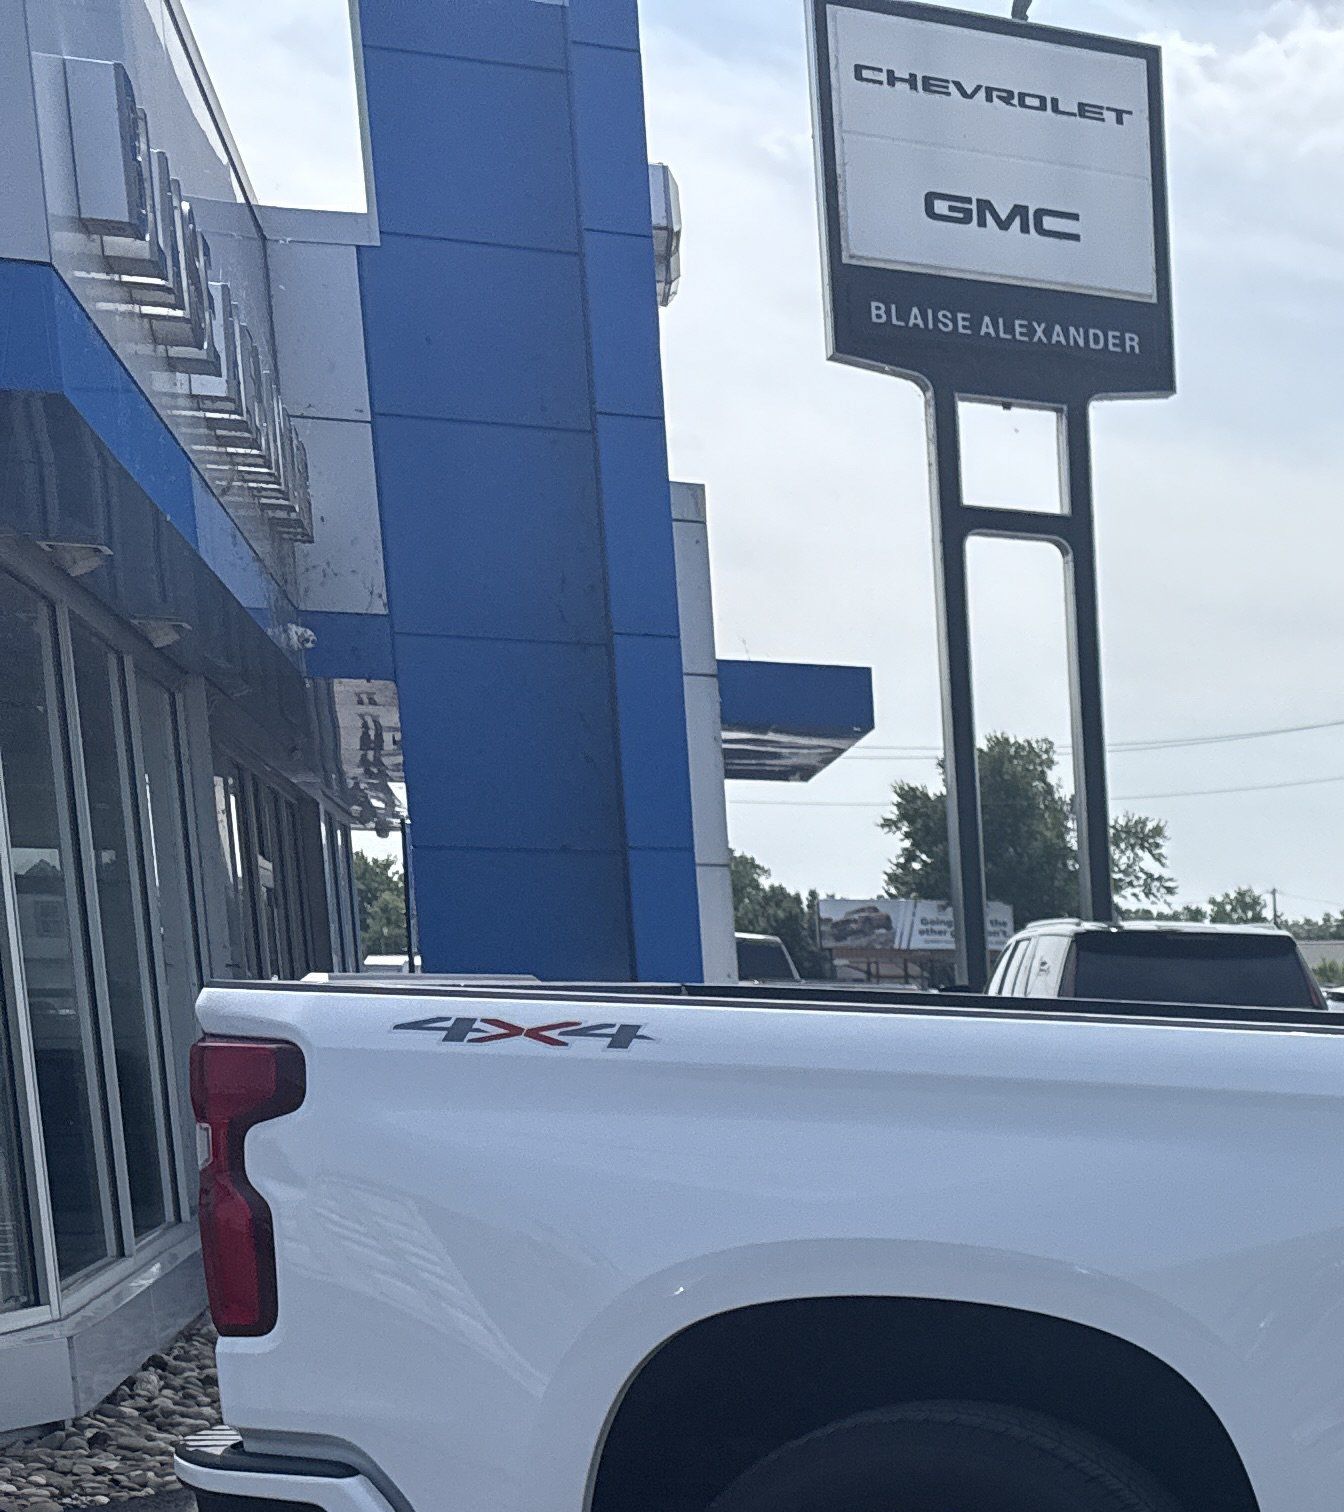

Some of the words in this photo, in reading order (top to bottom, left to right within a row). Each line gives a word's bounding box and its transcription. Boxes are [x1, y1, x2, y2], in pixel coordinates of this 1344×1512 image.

[853, 63, 1133, 126] CHEVROLET
[924, 191, 1081, 242] GMC
[870, 302, 972, 336] BLAISE
[981, 315, 1141, 355] ALEXANDER
